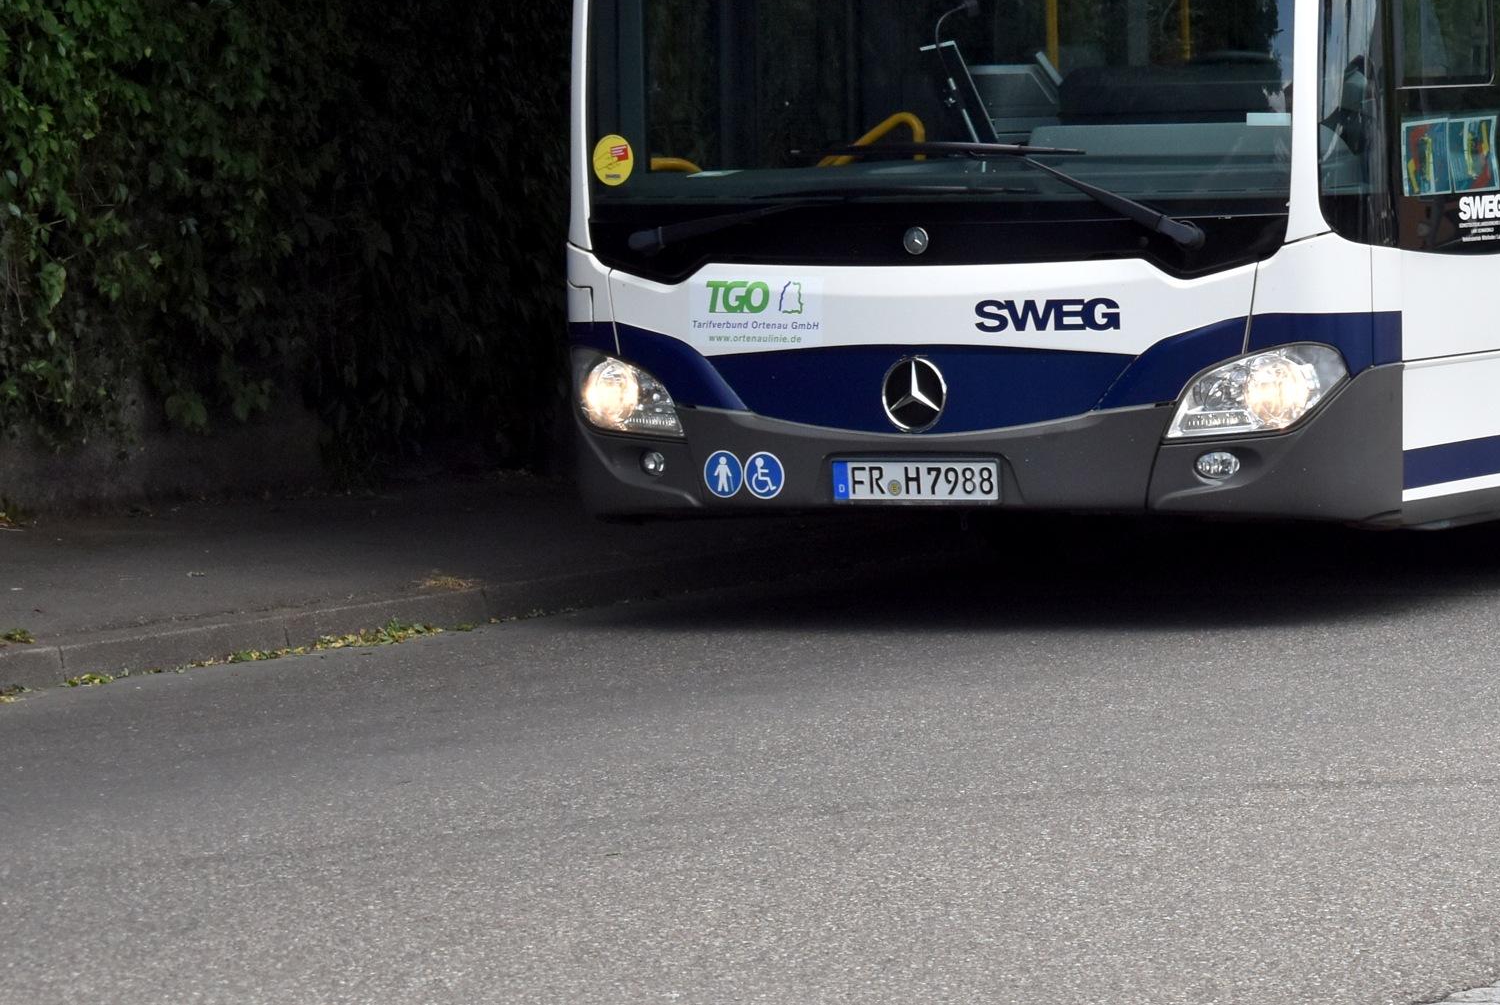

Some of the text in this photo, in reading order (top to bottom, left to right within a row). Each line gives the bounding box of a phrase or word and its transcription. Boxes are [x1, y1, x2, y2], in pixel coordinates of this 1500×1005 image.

[706, 280, 770, 314] TGO
[692, 320, 820, 331] Tarifverbund Ortenau GmbH
[974, 297, 1121, 334] SWEG
[708, 333, 802, 344] www.ortenaulinie.de
[851, 466, 886, 495] FR
